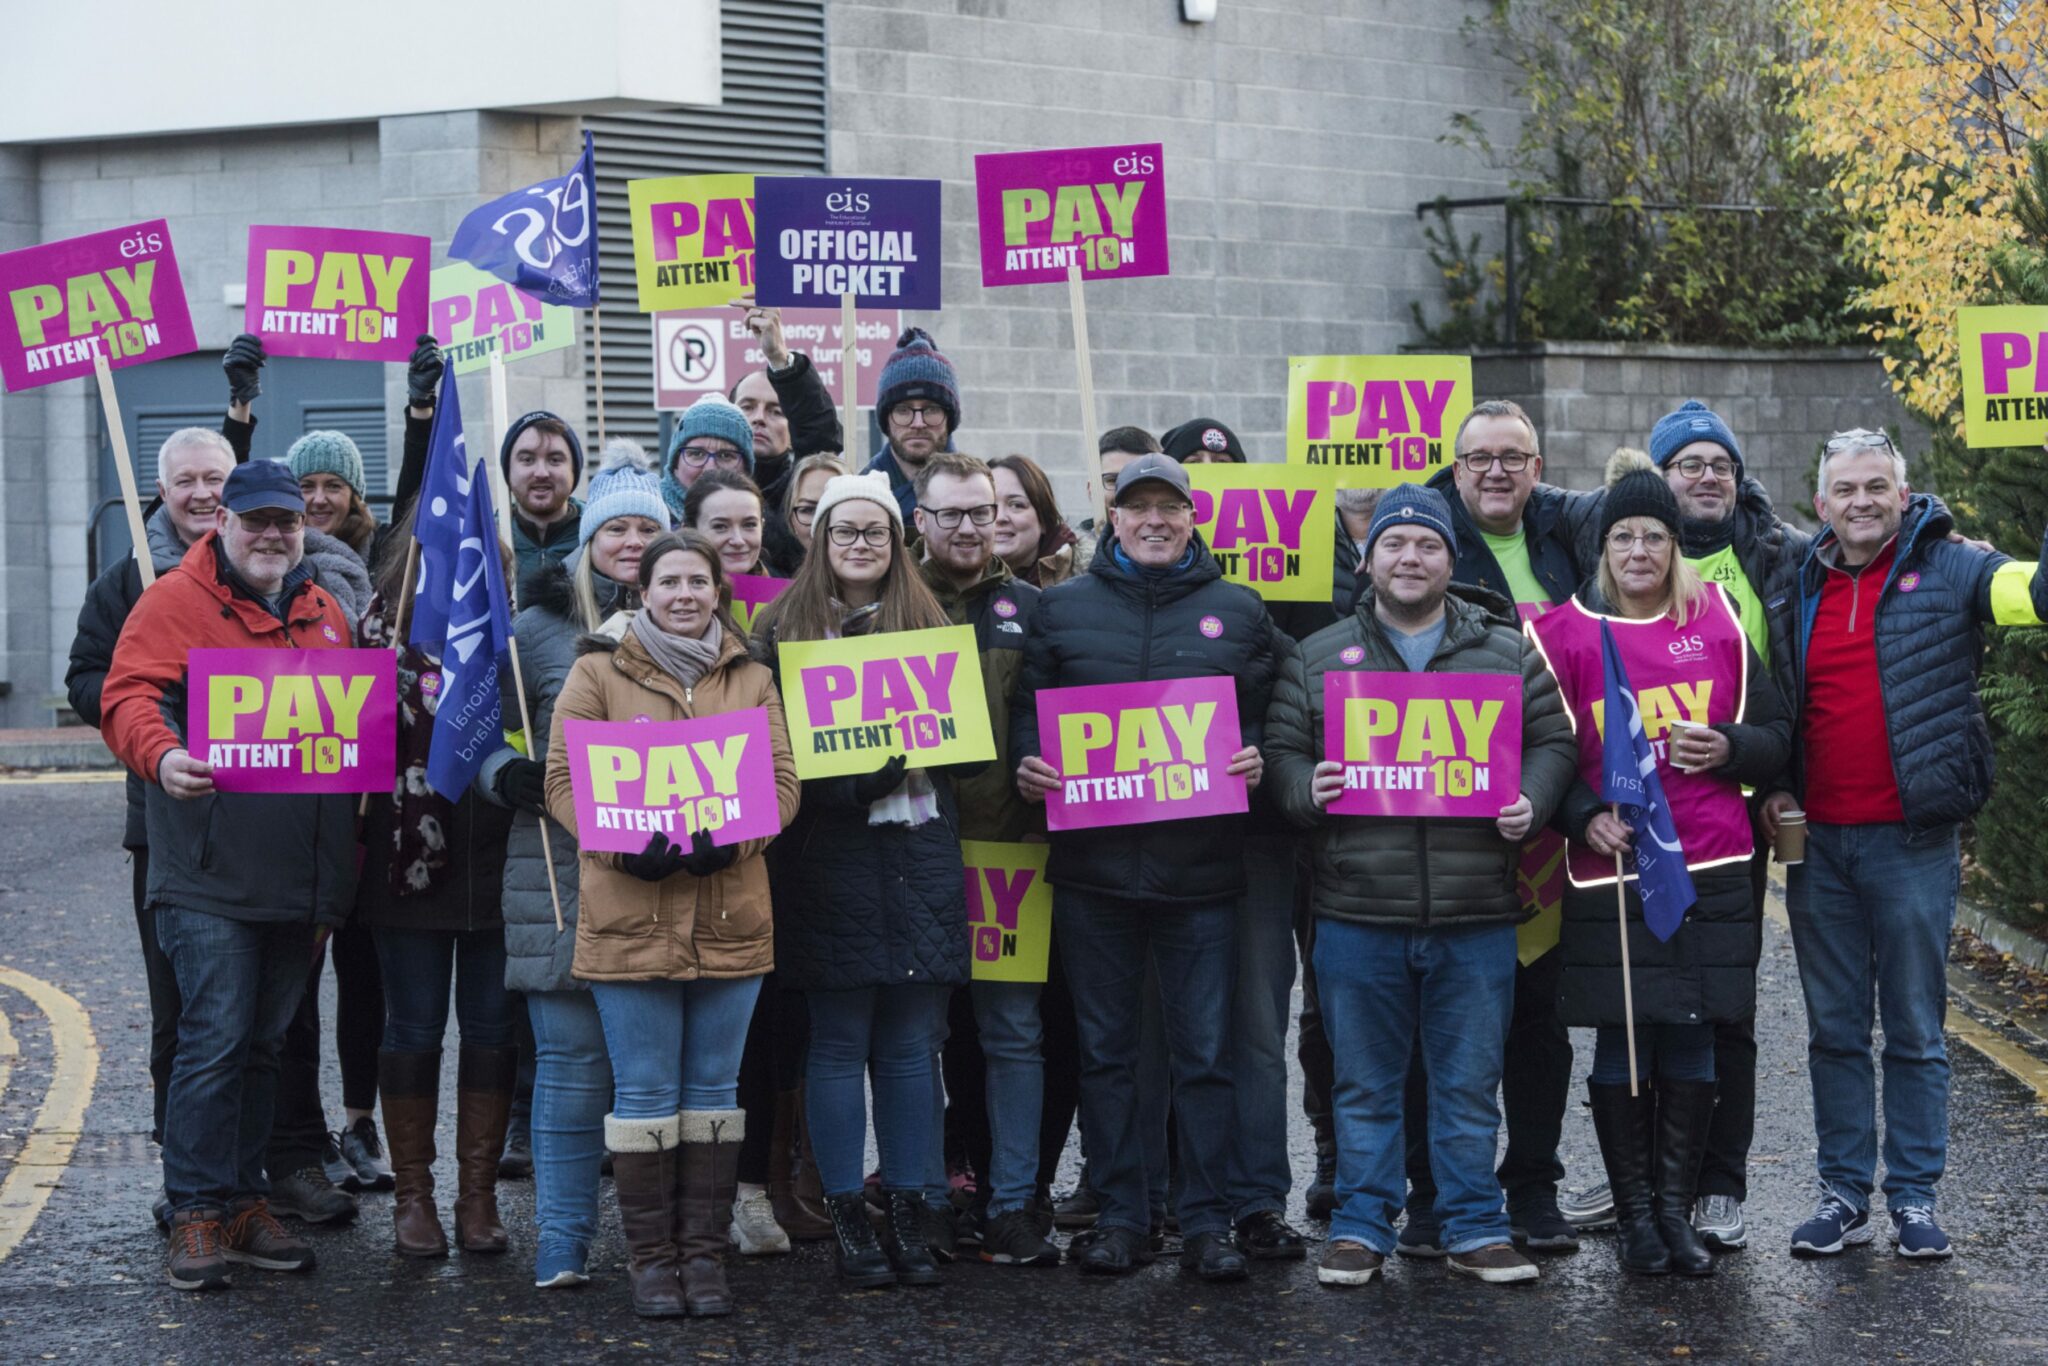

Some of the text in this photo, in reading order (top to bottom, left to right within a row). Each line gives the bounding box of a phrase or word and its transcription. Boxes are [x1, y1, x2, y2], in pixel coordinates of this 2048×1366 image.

[1113, 152, 1155, 176] eis
[650, 198, 755, 262] PA
[826, 187, 870, 213] eis
[1002, 181, 1146, 246] PAY
[119, 231, 163, 258] eis
[657, 252, 755, 287] ATTENT1
[779, 229, 917, 262] OFFICIAL
[8, 259, 156, 348] PAY
[263, 249, 413, 313] PAY
[793, 264, 905, 296] PICKET
[1306, 380, 1456, 440] PAY
[1668, 635, 1704, 655] eis
[208, 675, 377, 739] PAY
[800, 651, 960, 727] PAY
[1591, 679, 1714, 746] AY
[1058, 701, 1218, 777] PAY
[1344, 697, 1504, 763] PAY
[587, 733, 750, 807] PAY
